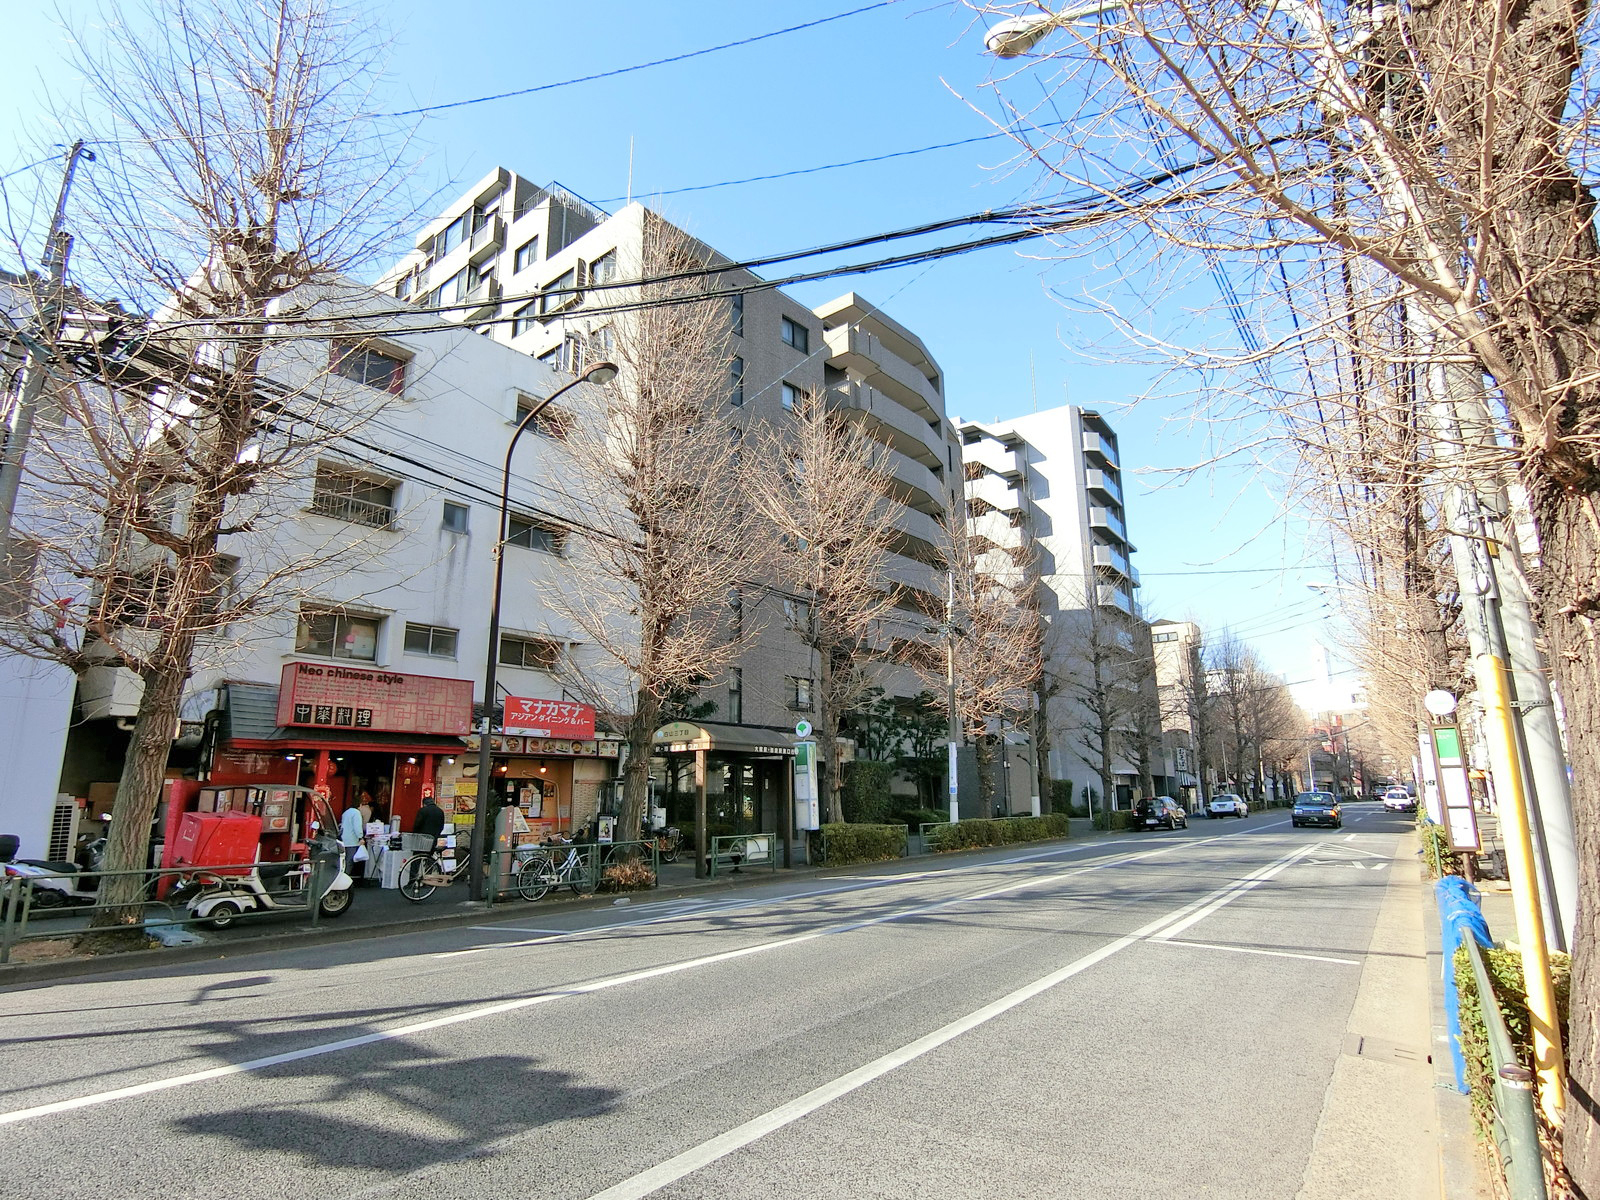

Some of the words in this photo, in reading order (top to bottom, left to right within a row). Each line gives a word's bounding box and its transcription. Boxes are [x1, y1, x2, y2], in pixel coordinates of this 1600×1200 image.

[298, 663, 324, 677] Neo
[327, 667, 374, 682] chinese
[377, 673, 404, 685] style
[295, 705, 372, 727] 中華料理
[520, 700, 585, 718] マナカマナ
